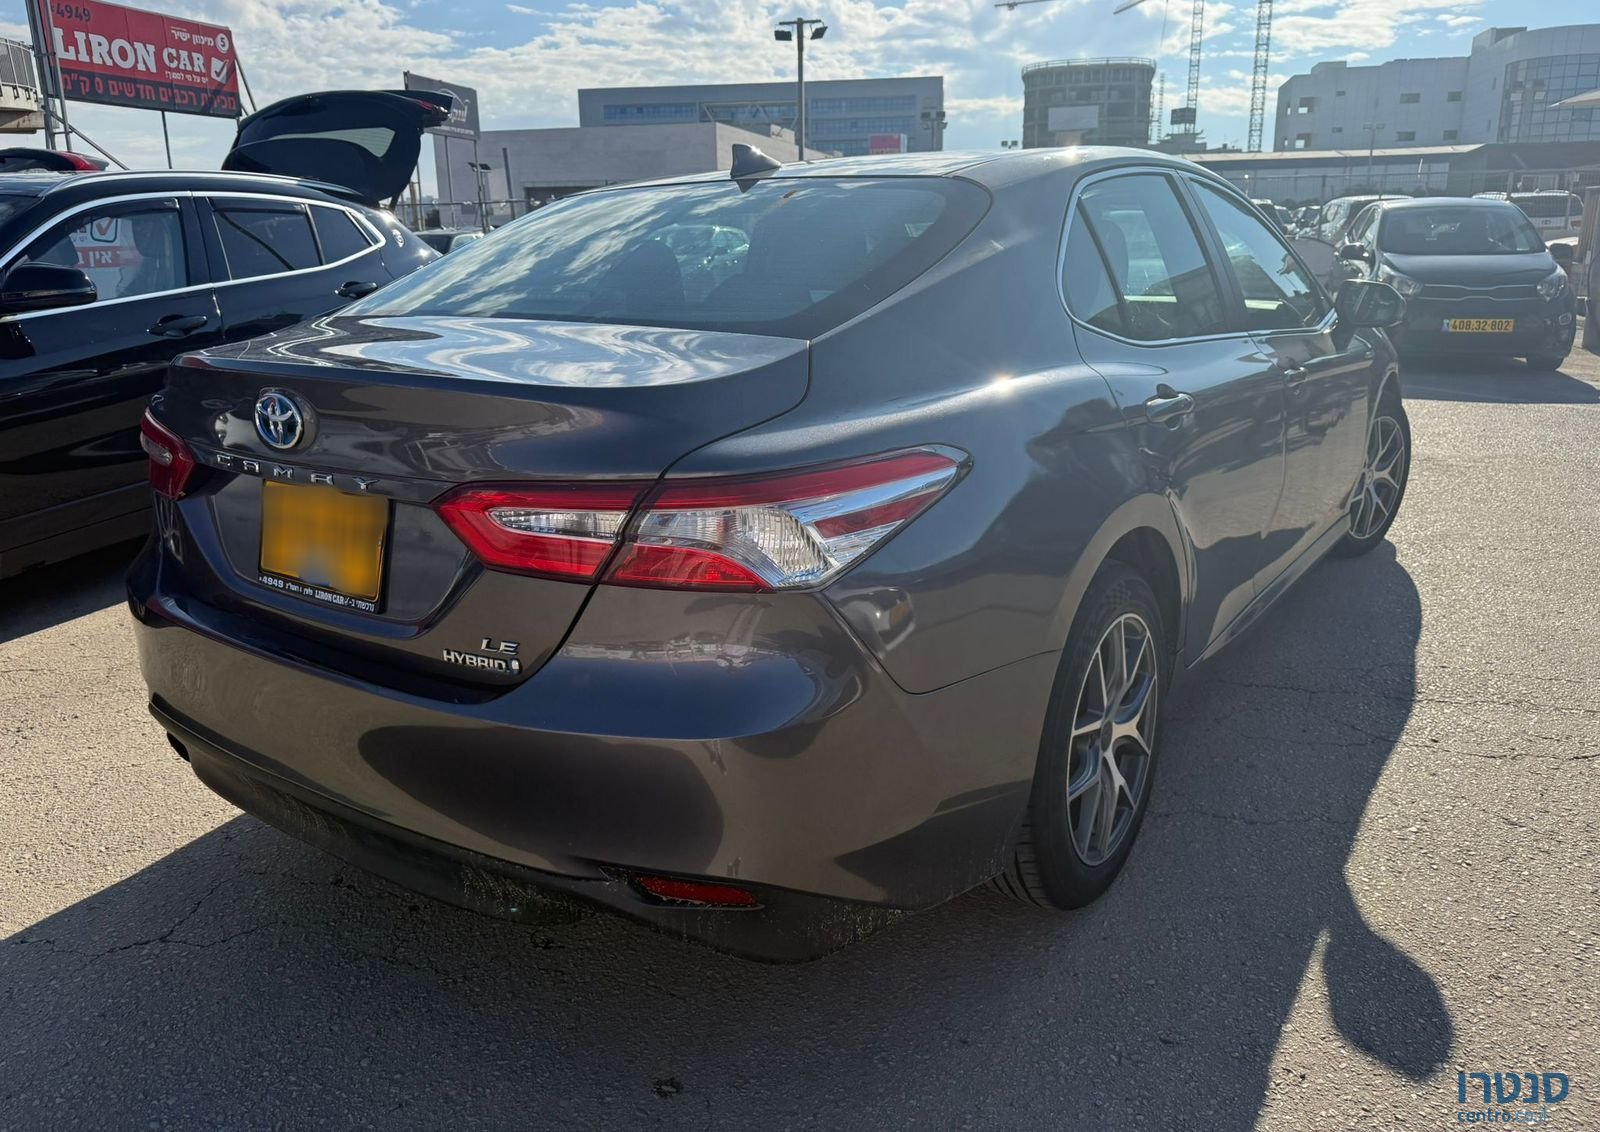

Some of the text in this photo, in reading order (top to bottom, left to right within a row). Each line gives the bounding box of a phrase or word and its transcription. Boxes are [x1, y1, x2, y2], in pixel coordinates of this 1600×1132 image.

[53, 27, 207, 73] LIRON CAR
[108, 80, 155, 101] חדשים
[160, 86, 197, 106] רכבים
[88, 250, 112, 267] אין
[216, 454, 381, 490] CAMRY
[315, 589, 332, 602] LIRON
[332, 594, 345, 605] CAR
[481, 638, 519, 655] LE
[443, 649, 506, 672] HYBRID
